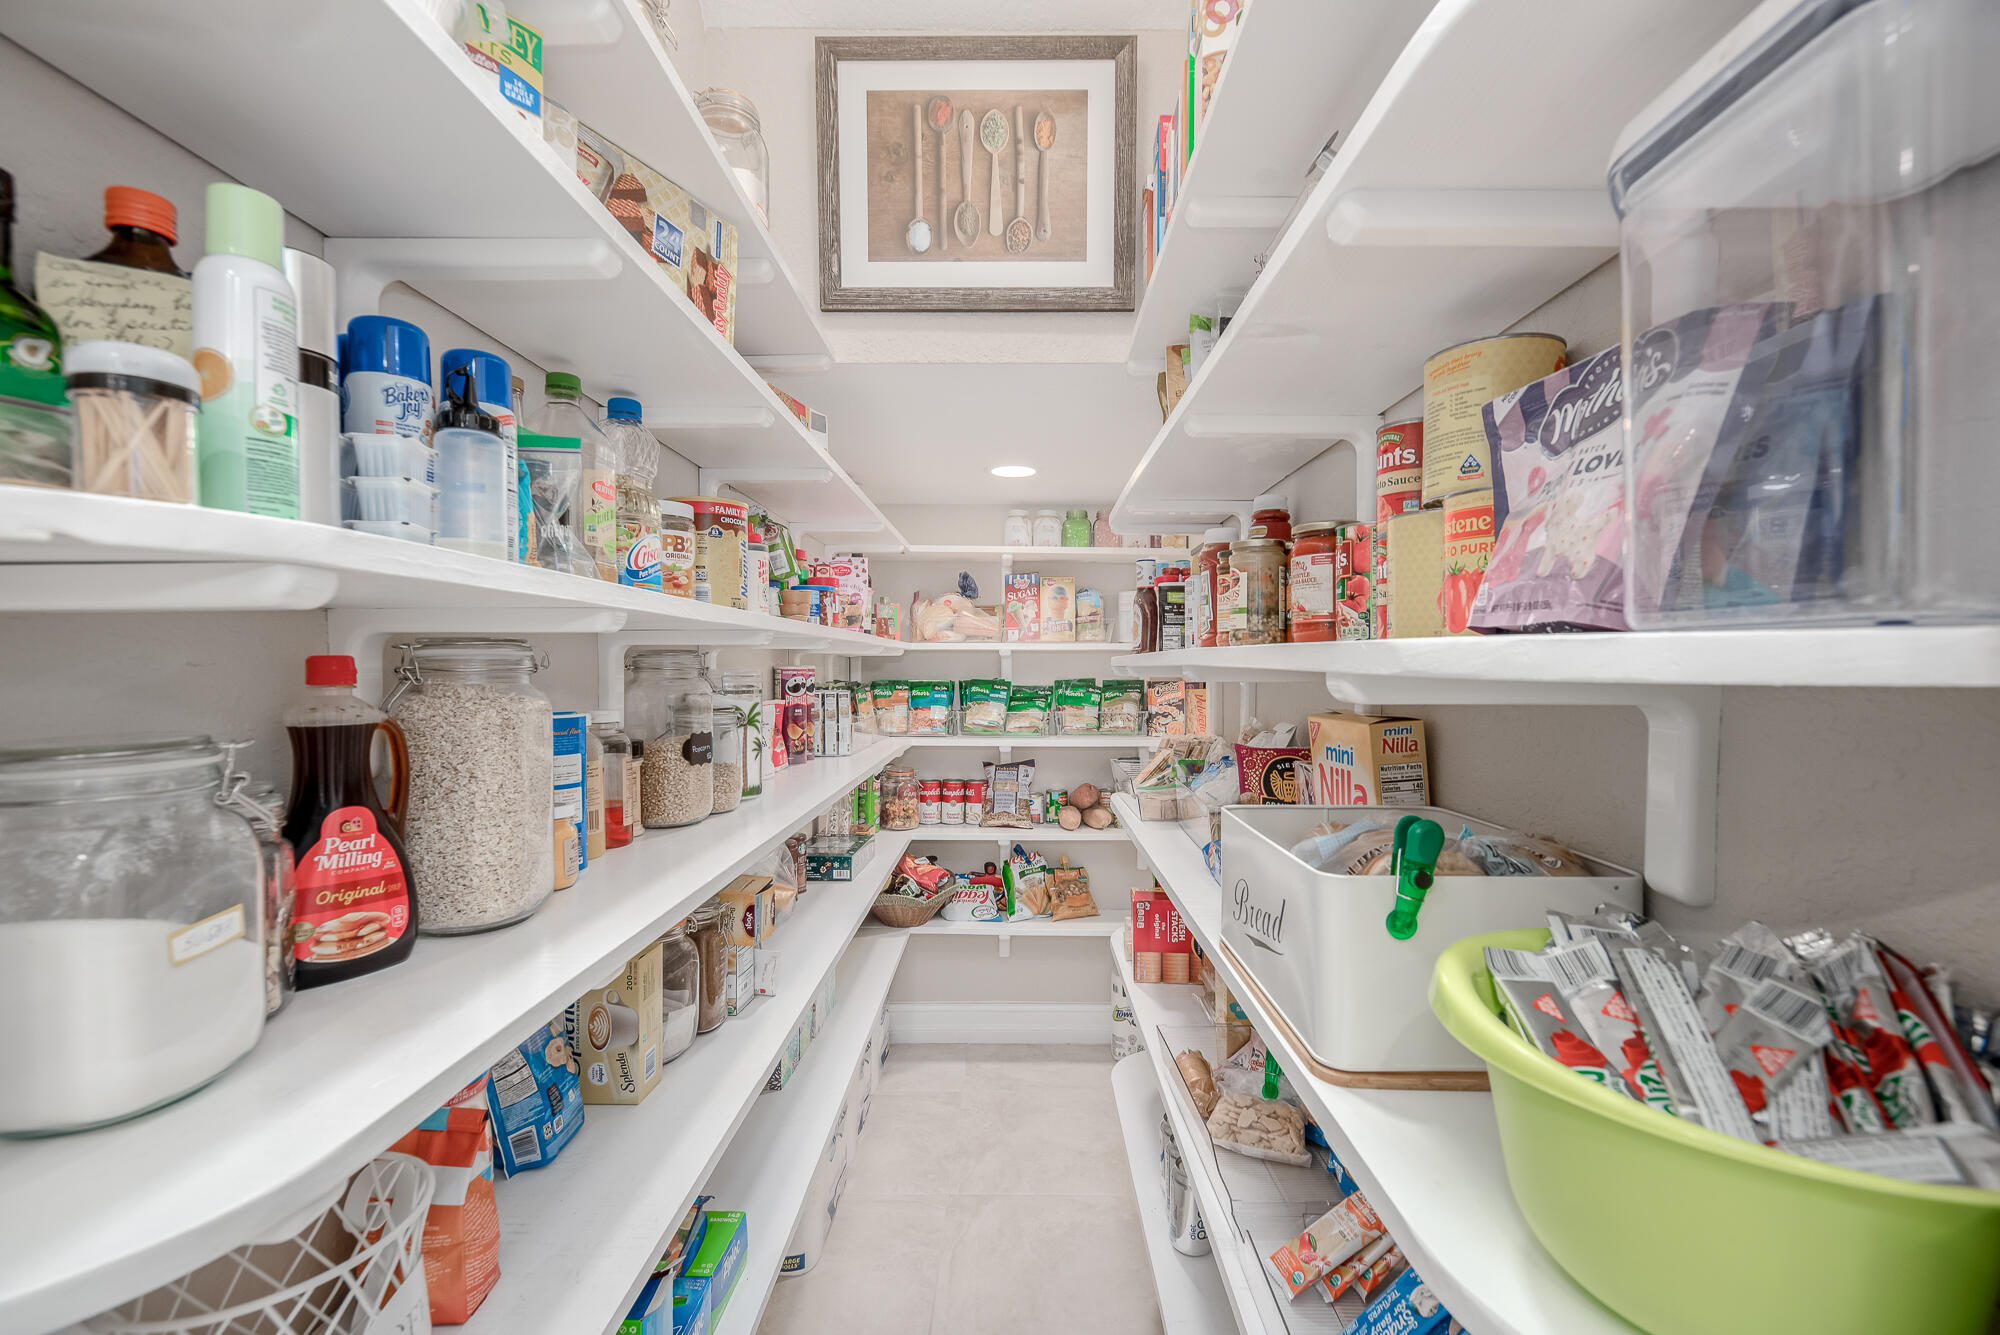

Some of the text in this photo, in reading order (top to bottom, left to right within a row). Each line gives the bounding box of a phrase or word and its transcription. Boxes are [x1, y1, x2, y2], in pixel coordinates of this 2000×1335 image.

[654, 240, 680, 264] COUNT
[1376, 447, 1416, 471] unt's
[1387, 474, 1421, 487] Sauce
[715, 505, 740, 516] FAMILY
[662, 534, 693, 553] PB2
[1007, 587, 1038, 601] SUGAR
[911, 689, 930, 697] Knorr
[970, 686, 990, 694] Knorr
[1065, 689, 1085, 697] Knorr
[1384, 724, 1412, 736] mini
[1382, 736, 1418, 754] Nilla
[1325, 744, 1354, 766] mini
[1407, 763, 1422, 771] Facts
[1318, 761, 1368, 806] Nilla
[1412, 782, 1424, 790] 140
[325, 833, 375, 854] Pearl
[303, 850, 383, 873] Milling
[316, 881, 386, 906] Original
[1233, 878, 1285, 943] Bread
[1153, 913, 1161, 939] original
[1171, 910, 1179, 943] STACKS
[616, 1051, 636, 1093] Splenda
[784, 1256, 800, 1265] ARGE
